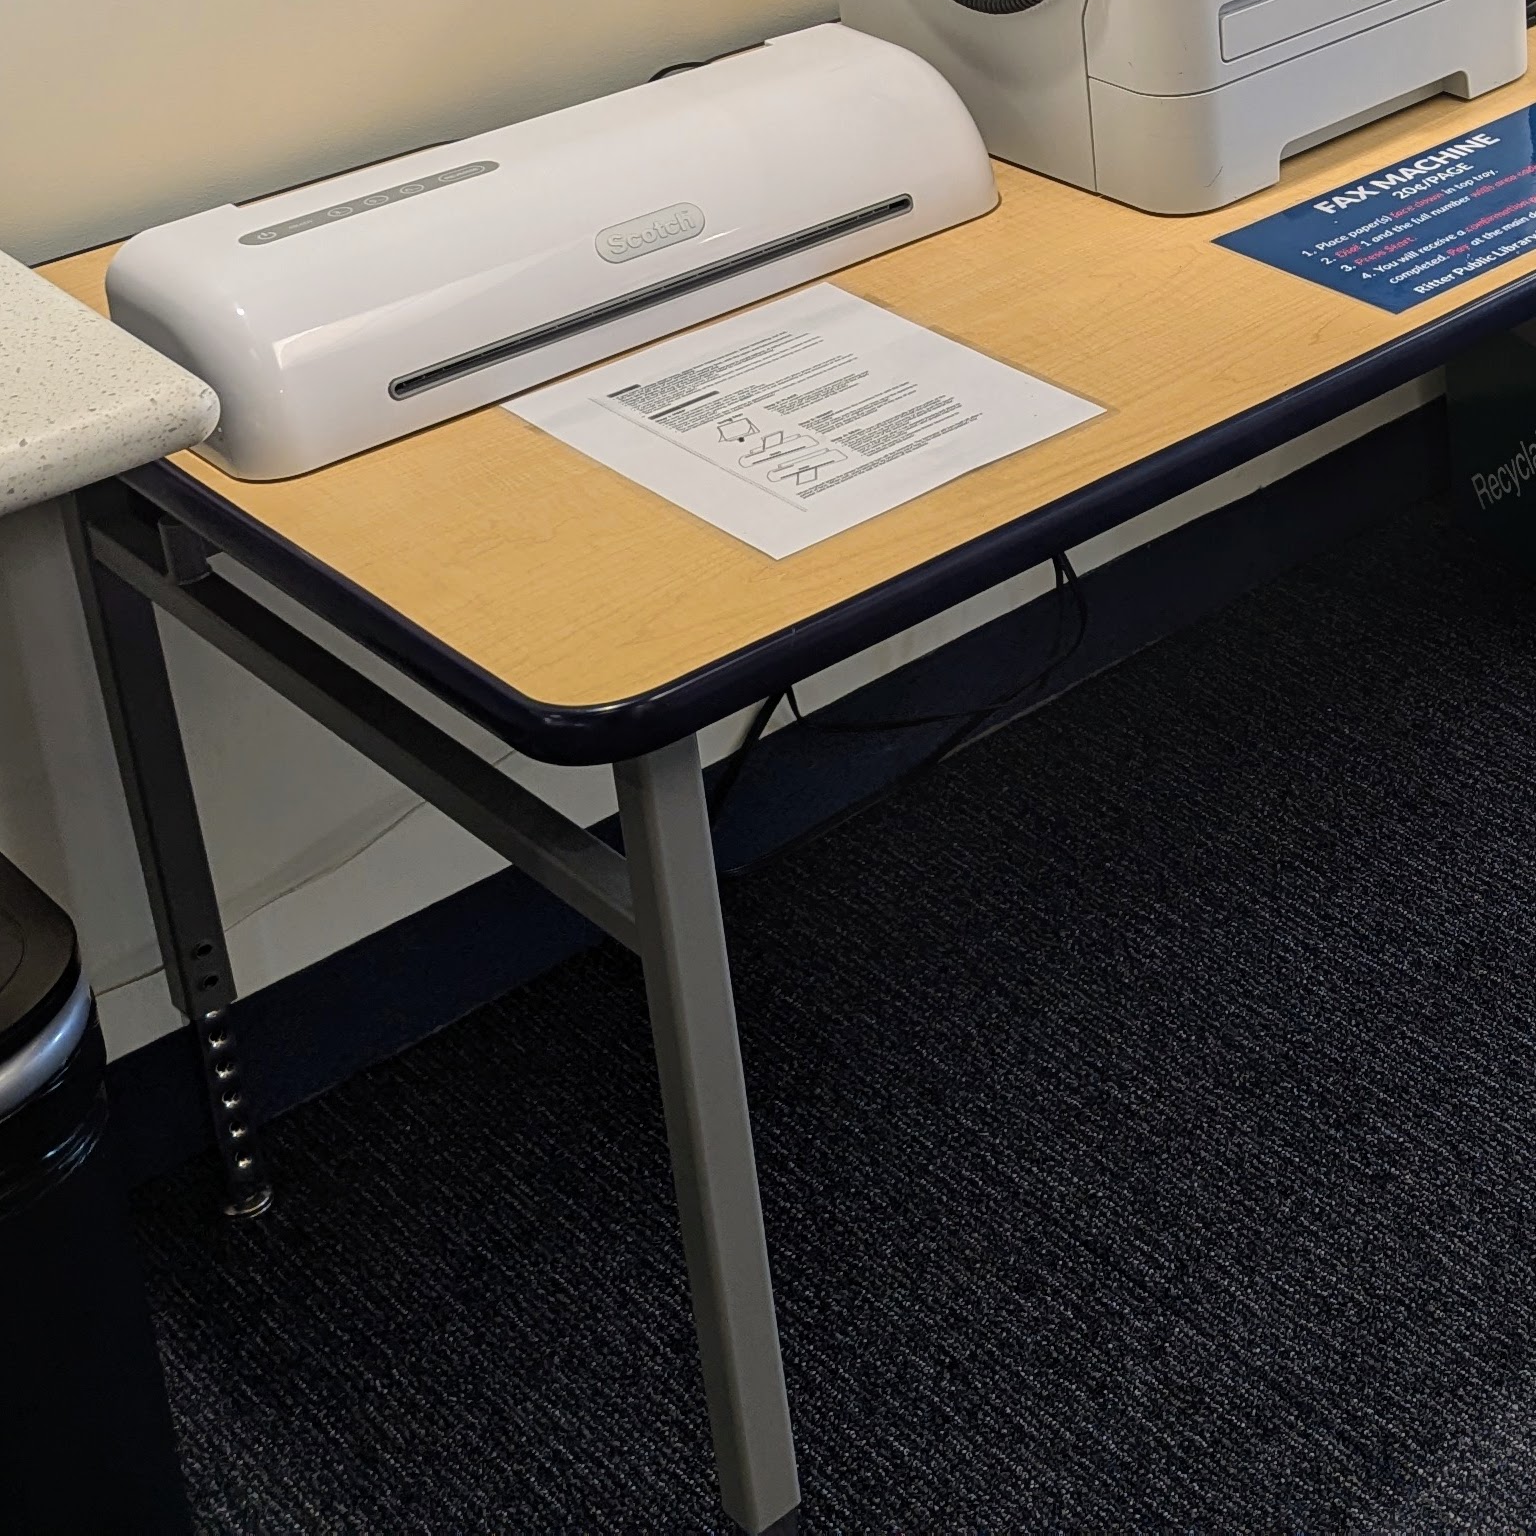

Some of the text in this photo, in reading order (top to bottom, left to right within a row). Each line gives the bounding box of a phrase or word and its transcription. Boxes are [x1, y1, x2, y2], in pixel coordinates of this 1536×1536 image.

[1313, 133, 1501, 214] FAX MACHINE
[1392, 162, 1474, 200] 20¢/PAGE
[607, 211, 696, 255] Scotch
[1301, 169, 1498, 258] 1. Place paper(s) face down in top tray.
[1320, 257, 1337, 265] 2.
[1334, 244, 1362, 259] Dial
[1371, 230, 1395, 243] and
[1392, 221, 1414, 233] the
[1411, 213, 1432, 225] full
[1431, 195, 1471, 217] number
[1470, 185, 1496, 198] with
[1494, 174, 1519, 188] area
[1361, 272, 1377, 280] 4.
[1373, 259, 1400, 273] You
[1397, 250, 1419, 263] will
[1417, 233, 1457, 254] receive
[1456, 229, 1466, 237] a
[1465, 199, 1531, 233] confirmation
[1340, 264, 1357, 273] 3.
[1354, 250, 1387, 266] Press
[1389, 254, 1451, 284] completed.
[1446, 243, 1471, 257] Pay
[1470, 237, 1485, 246] at
[1482, 228, 1504, 240] the
[1502, 216, 1530, 232] main
[1413, 271, 1455, 294] Ritter
[1452, 253, 1497, 276] Public
